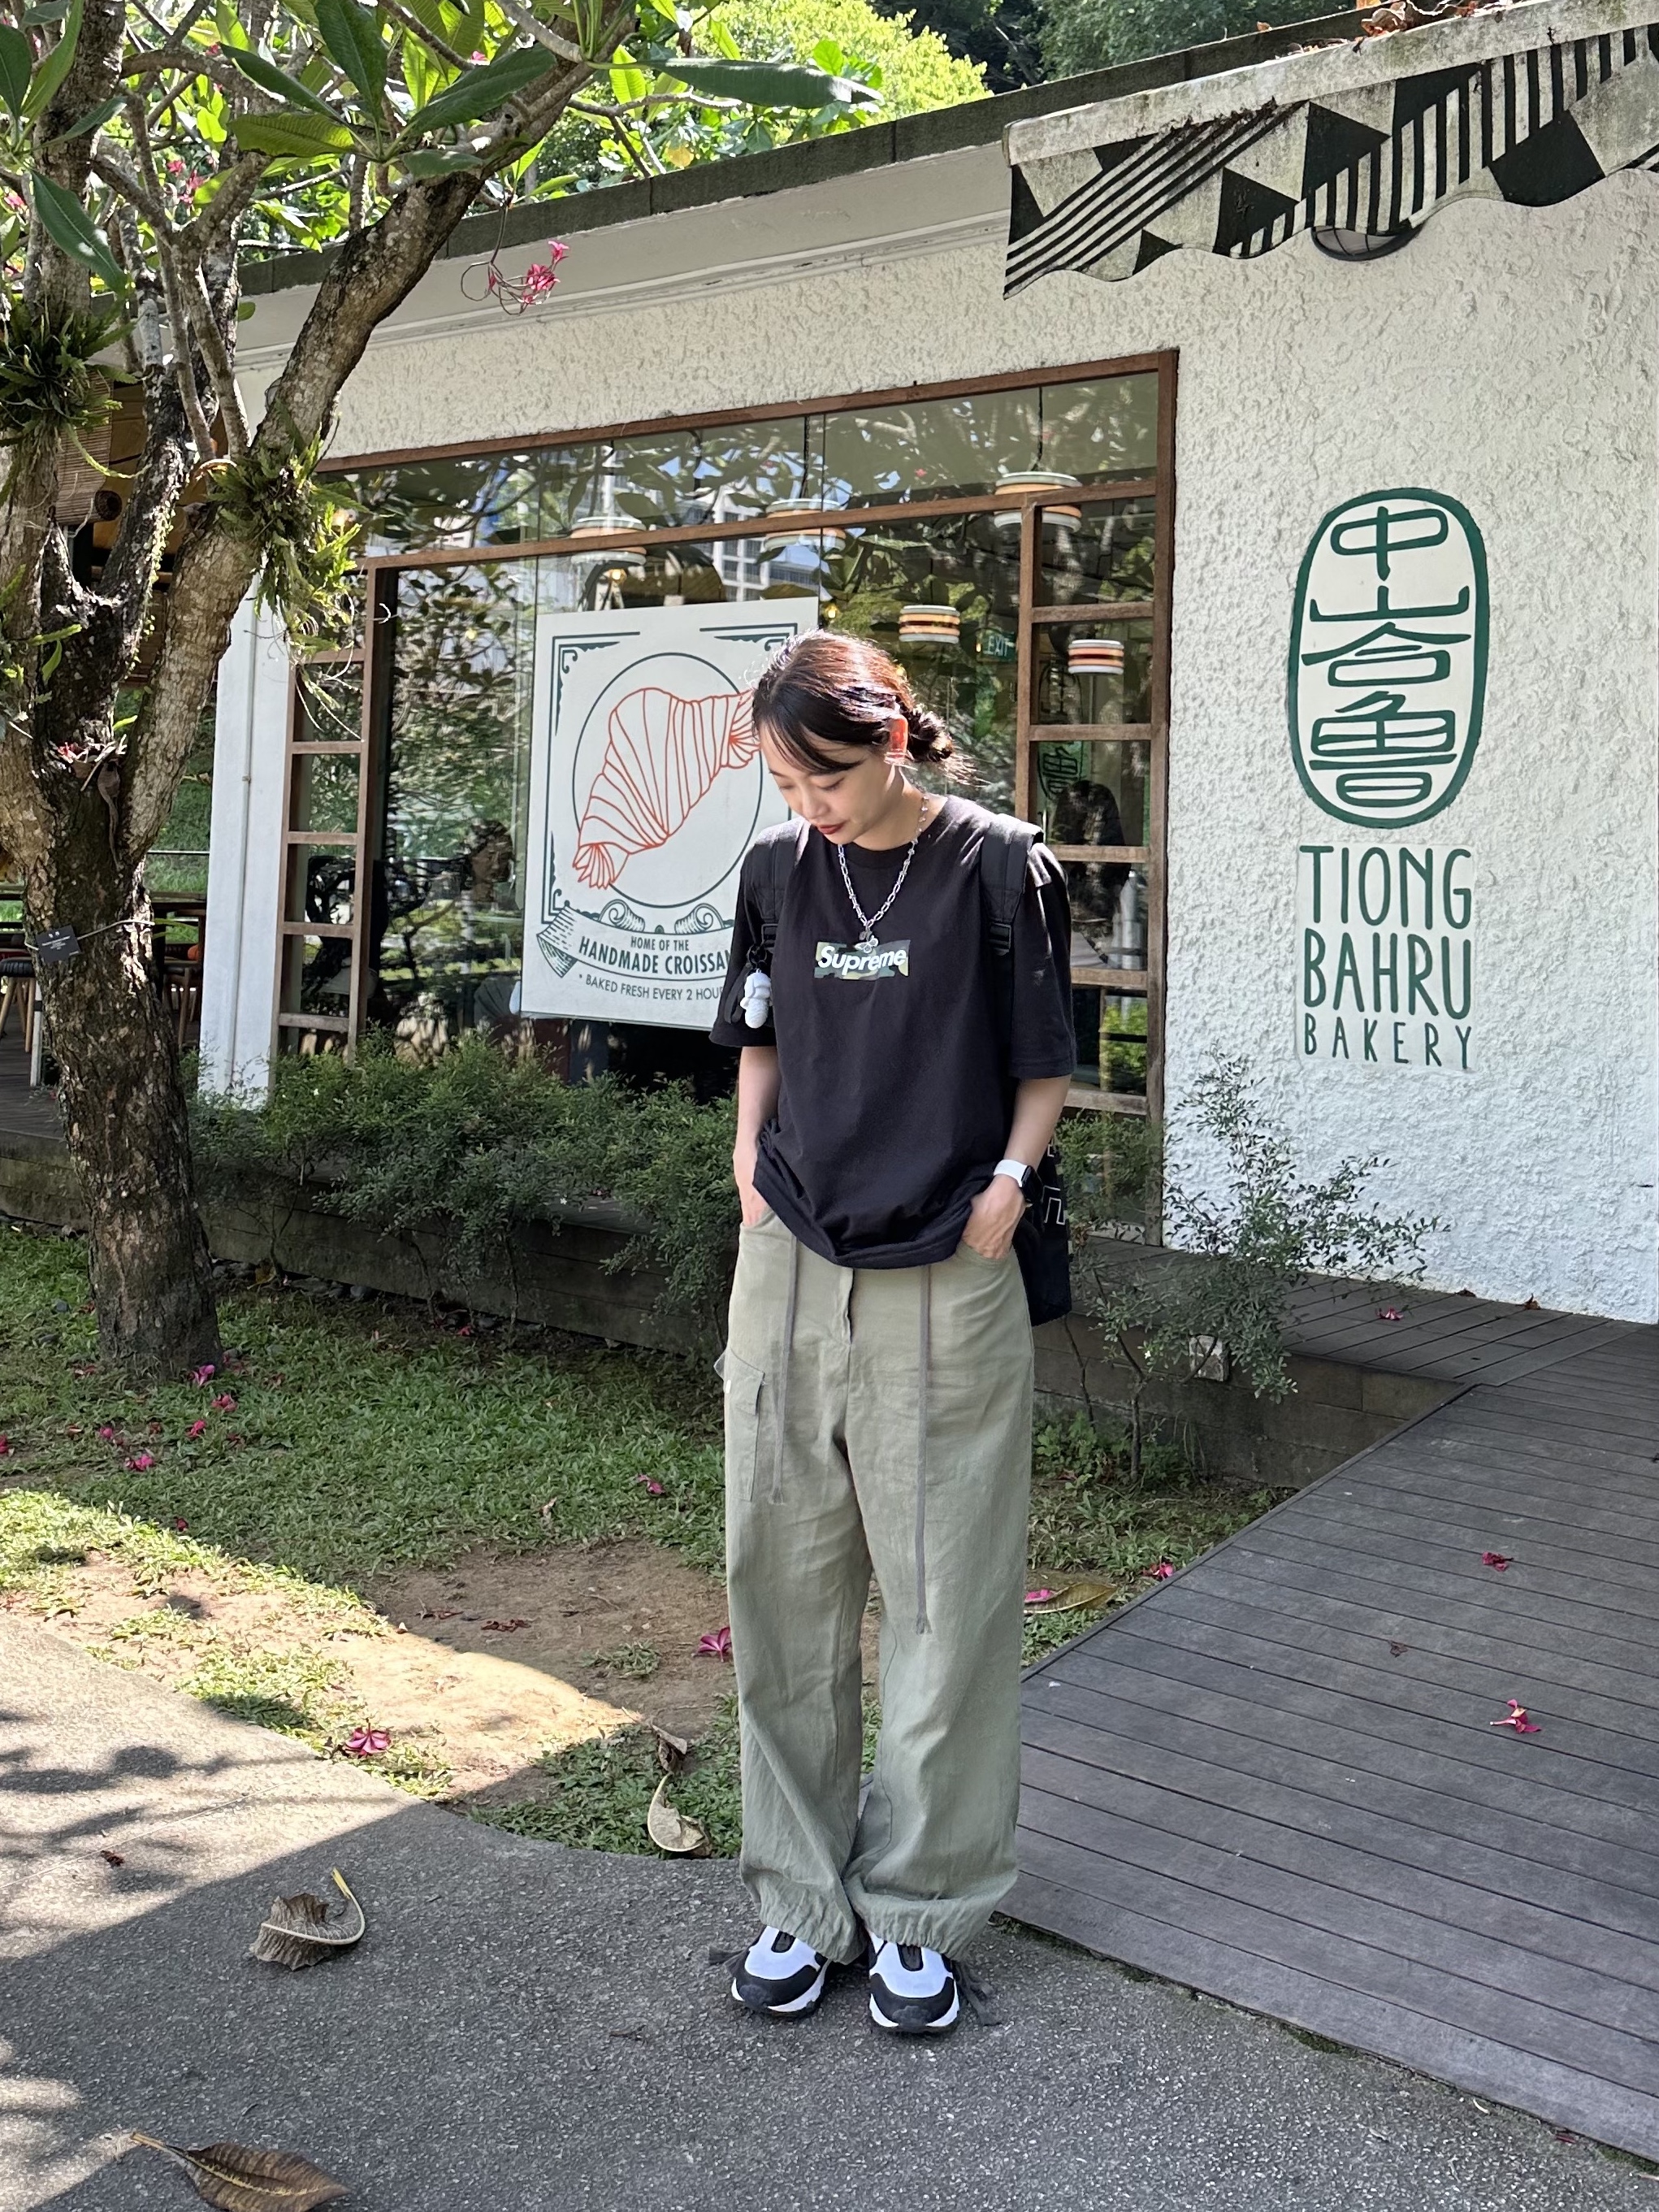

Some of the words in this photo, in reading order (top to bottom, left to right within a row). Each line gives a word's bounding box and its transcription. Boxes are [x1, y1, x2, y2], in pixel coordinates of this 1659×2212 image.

[1300, 845, 1471, 930] TIONG
[578, 935, 658, 974] HANDMADE
[630, 935, 656, 950] HOME
[659, 939, 670, 952] OF
[674, 939, 689, 952] THE
[818, 945, 907, 975] Supreme
[586, 974, 618, 993] BAKED
[621, 982, 650, 1000] FRESH
[652, 987, 683, 1000] EVERY
[687, 988, 692, 1000] 2
[1304, 927, 1471, 1020] BAHRU
[1305, 1013, 1471, 1069] BAKERY
